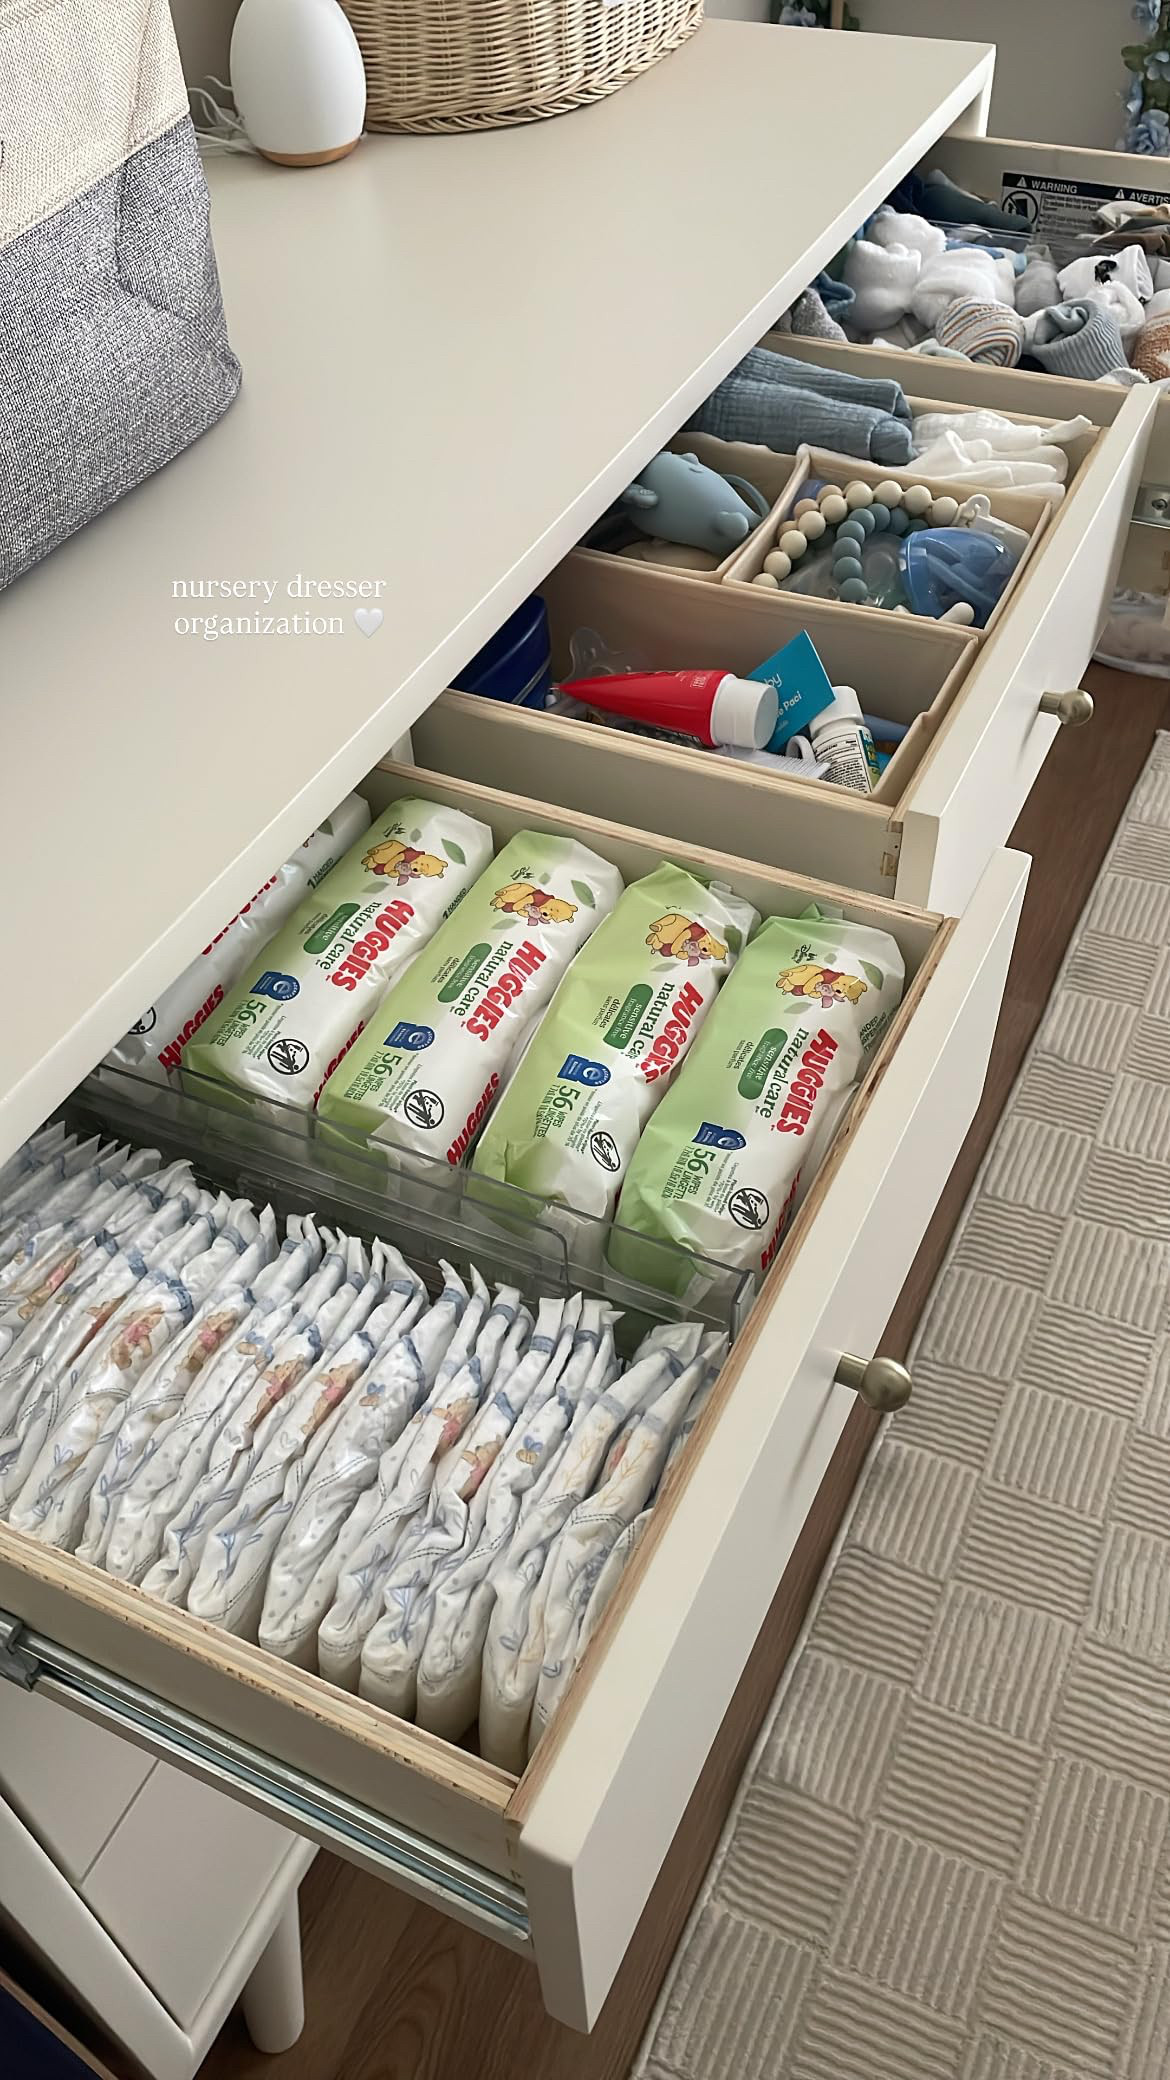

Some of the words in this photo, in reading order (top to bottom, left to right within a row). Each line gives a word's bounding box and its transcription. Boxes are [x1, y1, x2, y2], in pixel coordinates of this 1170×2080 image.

[1031, 181, 1078, 194] WARNING
[341, 902, 382, 944] natural
[319, 943, 345, 970] care
[332, 900, 414, 992] HUGGIES
[474, 941, 513, 989] natural
[454, 987, 480, 1016] care
[466, 940, 547, 1042] HUGGIES
[158, 984, 224, 1068] HUGGIES
[238, 999, 267, 1024] 56
[600, 998, 621, 1028] délicates
[619, 1003, 642, 1039] sensitive
[639, 983, 675, 1040] natural
[641, 981, 704, 1084] HUGGIES
[374, 1053, 402, 1077] 56
[733, 1041, 754, 1070] délicates
[755, 1046, 777, 1080] sensitive
[772, 1027, 809, 1084] natural
[353, 1074, 378, 1101] LINGETTES
[370, 1076, 386, 1092] WIPES
[776, 1028, 839, 1136] HUGGIES
[553, 1085, 581, 1111] 56
[760, 1082, 782, 1118] care
[447, 1072, 499, 1166] HUGGIES
[537, 1107, 557, 1138] LINGETTES
[553, 1111, 567, 1128] WIPES
[687, 1148, 716, 1175] 56
[687, 1175, 703, 1195] WIPES
